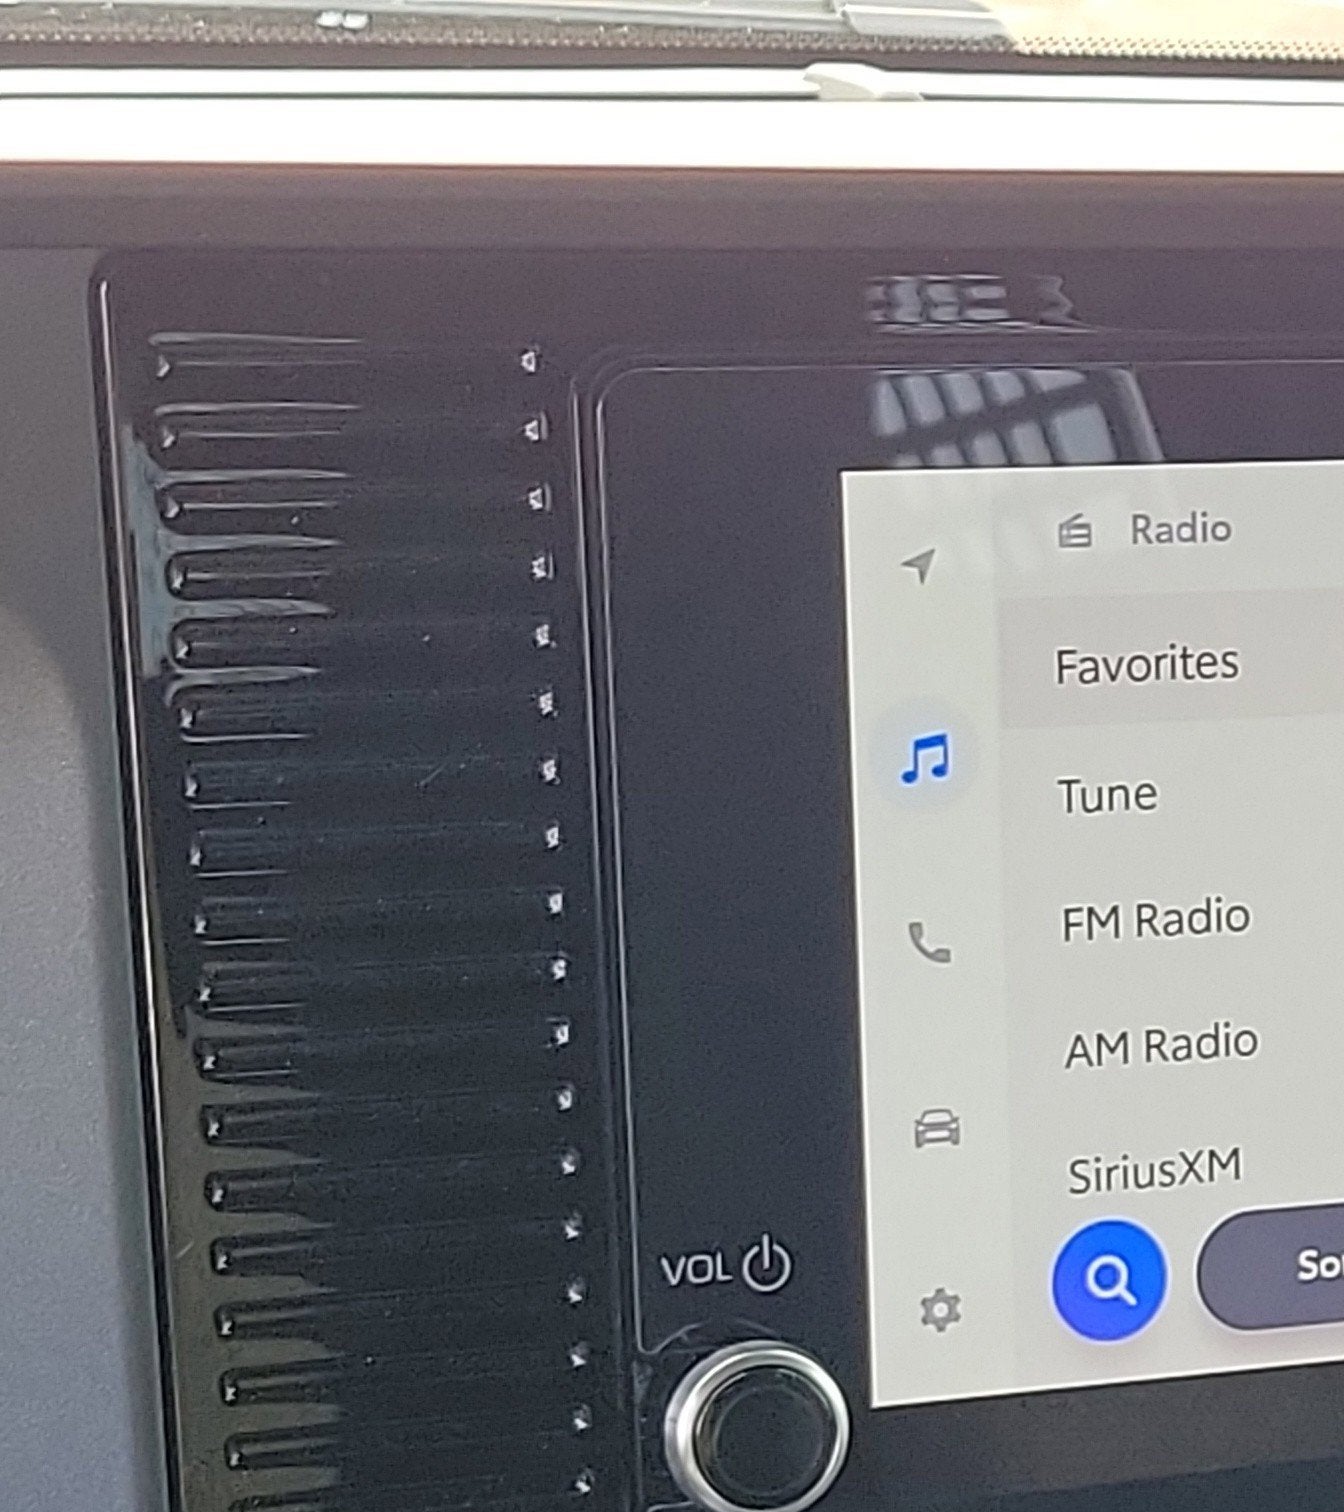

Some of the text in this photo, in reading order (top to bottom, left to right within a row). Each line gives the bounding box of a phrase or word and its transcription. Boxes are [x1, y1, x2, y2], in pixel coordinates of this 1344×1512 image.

[1132, 510, 1232, 545] Radio
[1057, 643, 1239, 685] Favorites
[1057, 779, 1157, 814] Tune
[1064, 896, 1250, 942] FM Radio
[1065, 1021, 1258, 1069] AM Radio
[1069, 1147, 1243, 1195] SiriusXM
[660, 1251, 734, 1287] VOL
